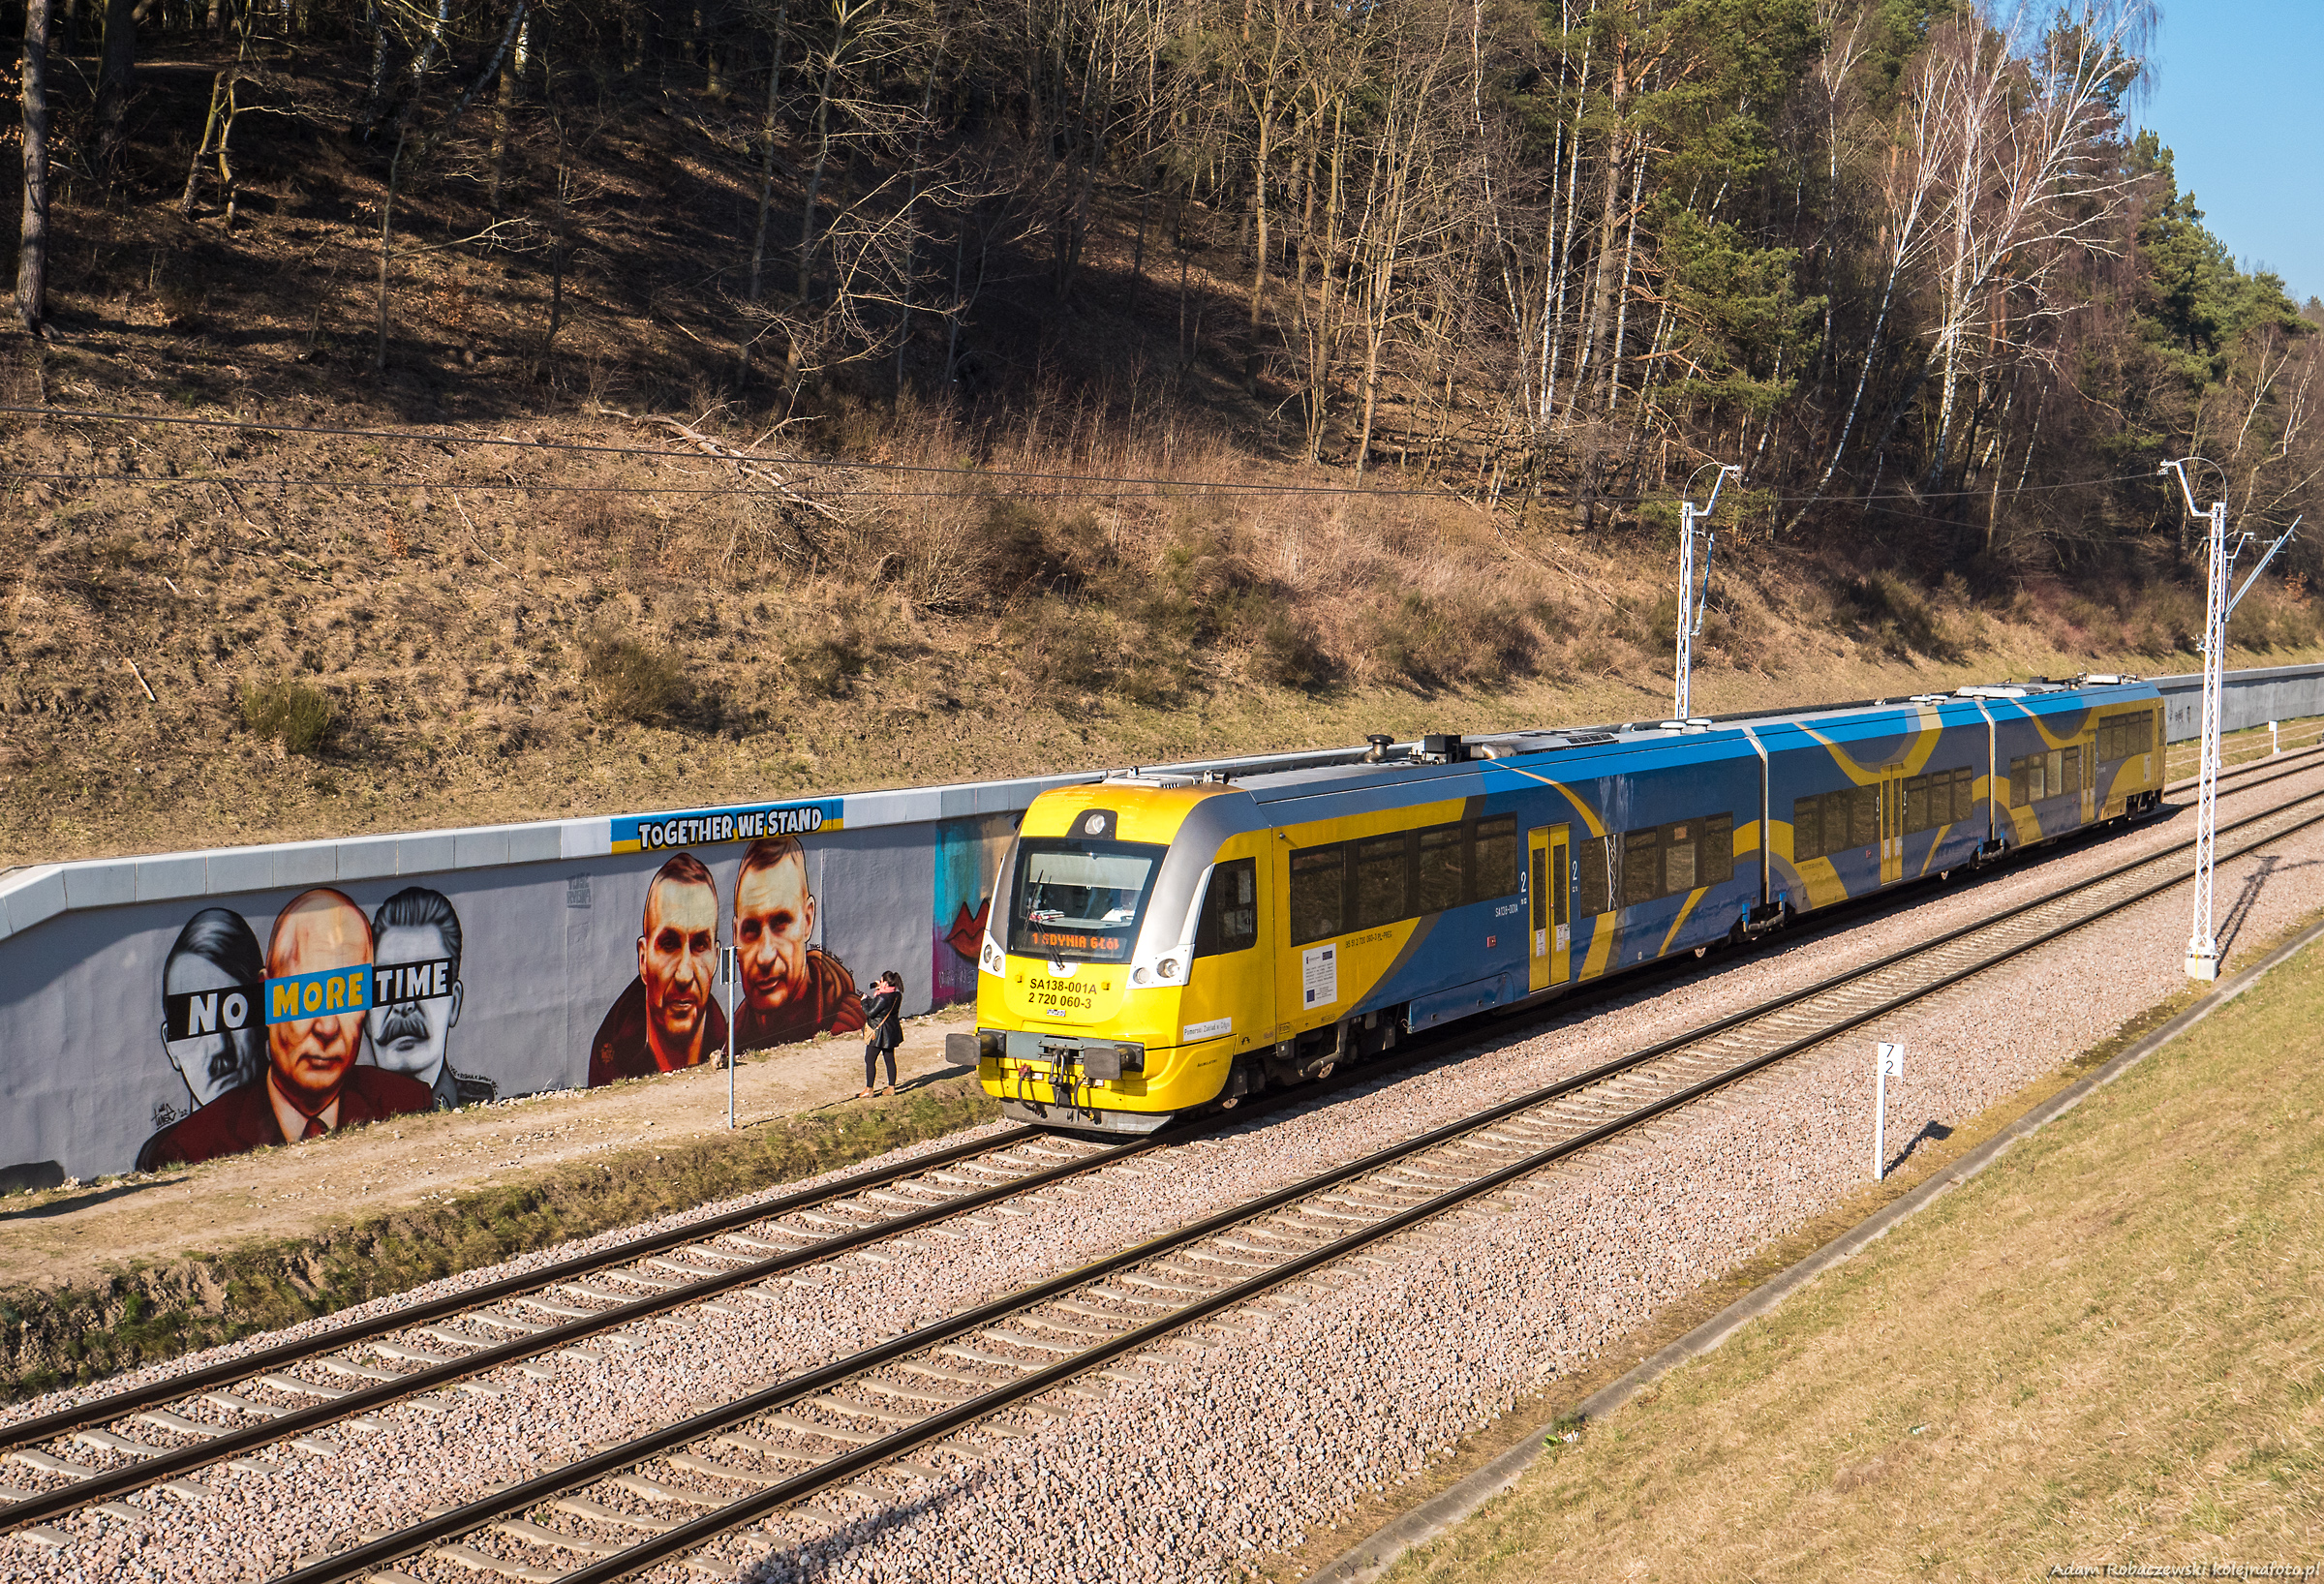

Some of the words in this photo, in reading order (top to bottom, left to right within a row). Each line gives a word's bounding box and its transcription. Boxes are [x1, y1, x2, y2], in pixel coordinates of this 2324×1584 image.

[638, 815, 734, 848] TOGETHER
[737, 811, 765, 838] WE
[768, 807, 823, 836] STAND
[1573, 860, 1578, 881] 2
[1520, 870, 1527, 893] 2
[1032, 932, 1038, 944] 1
[1042, 932, 1086, 949] GDYNIA
[1029, 978, 1097, 994] SA138-001A
[188, 992, 249, 1036] NO
[273, 972, 364, 1018] MORE
[376, 961, 448, 1003] TIME
[1028, 992, 1035, 1003] 2
[1038, 993, 1056, 1005] 720
[1060, 995, 1091, 1009] 060-3
[1886, 1044, 1894, 1058] 7
[1885, 1059, 1894, 1075] 2
